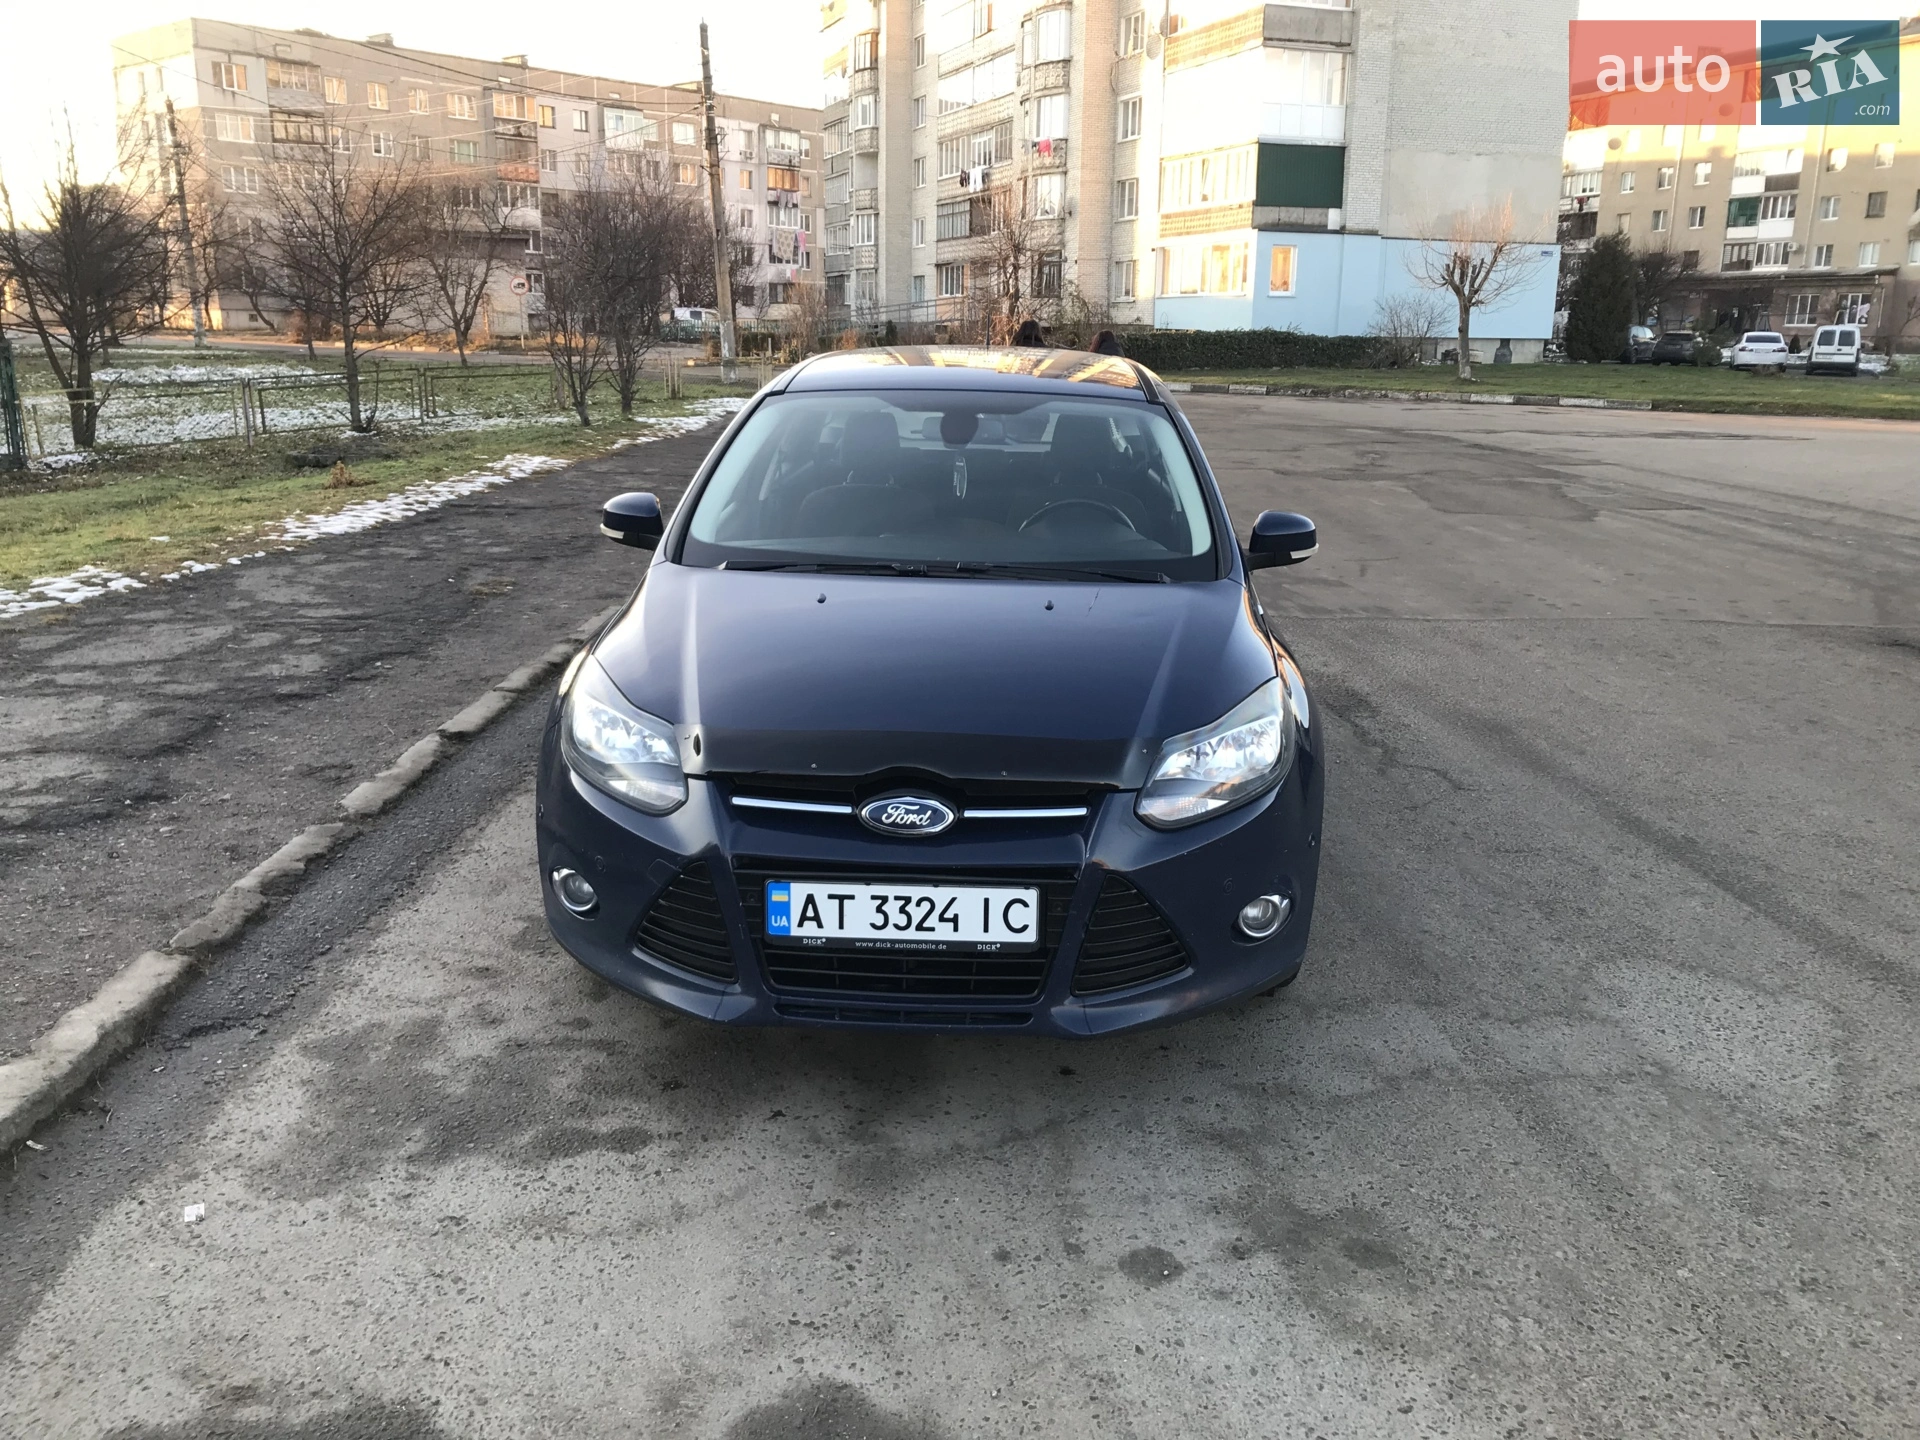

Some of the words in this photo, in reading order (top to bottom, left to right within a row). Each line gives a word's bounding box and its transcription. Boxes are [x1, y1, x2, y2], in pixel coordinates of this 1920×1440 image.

[881, 804, 931, 826] Ford
[771, 915, 789, 927] UA
[797, 893, 856, 930] AT
[869, 895, 960, 933] 3324
[983, 897, 1030, 934] IC
